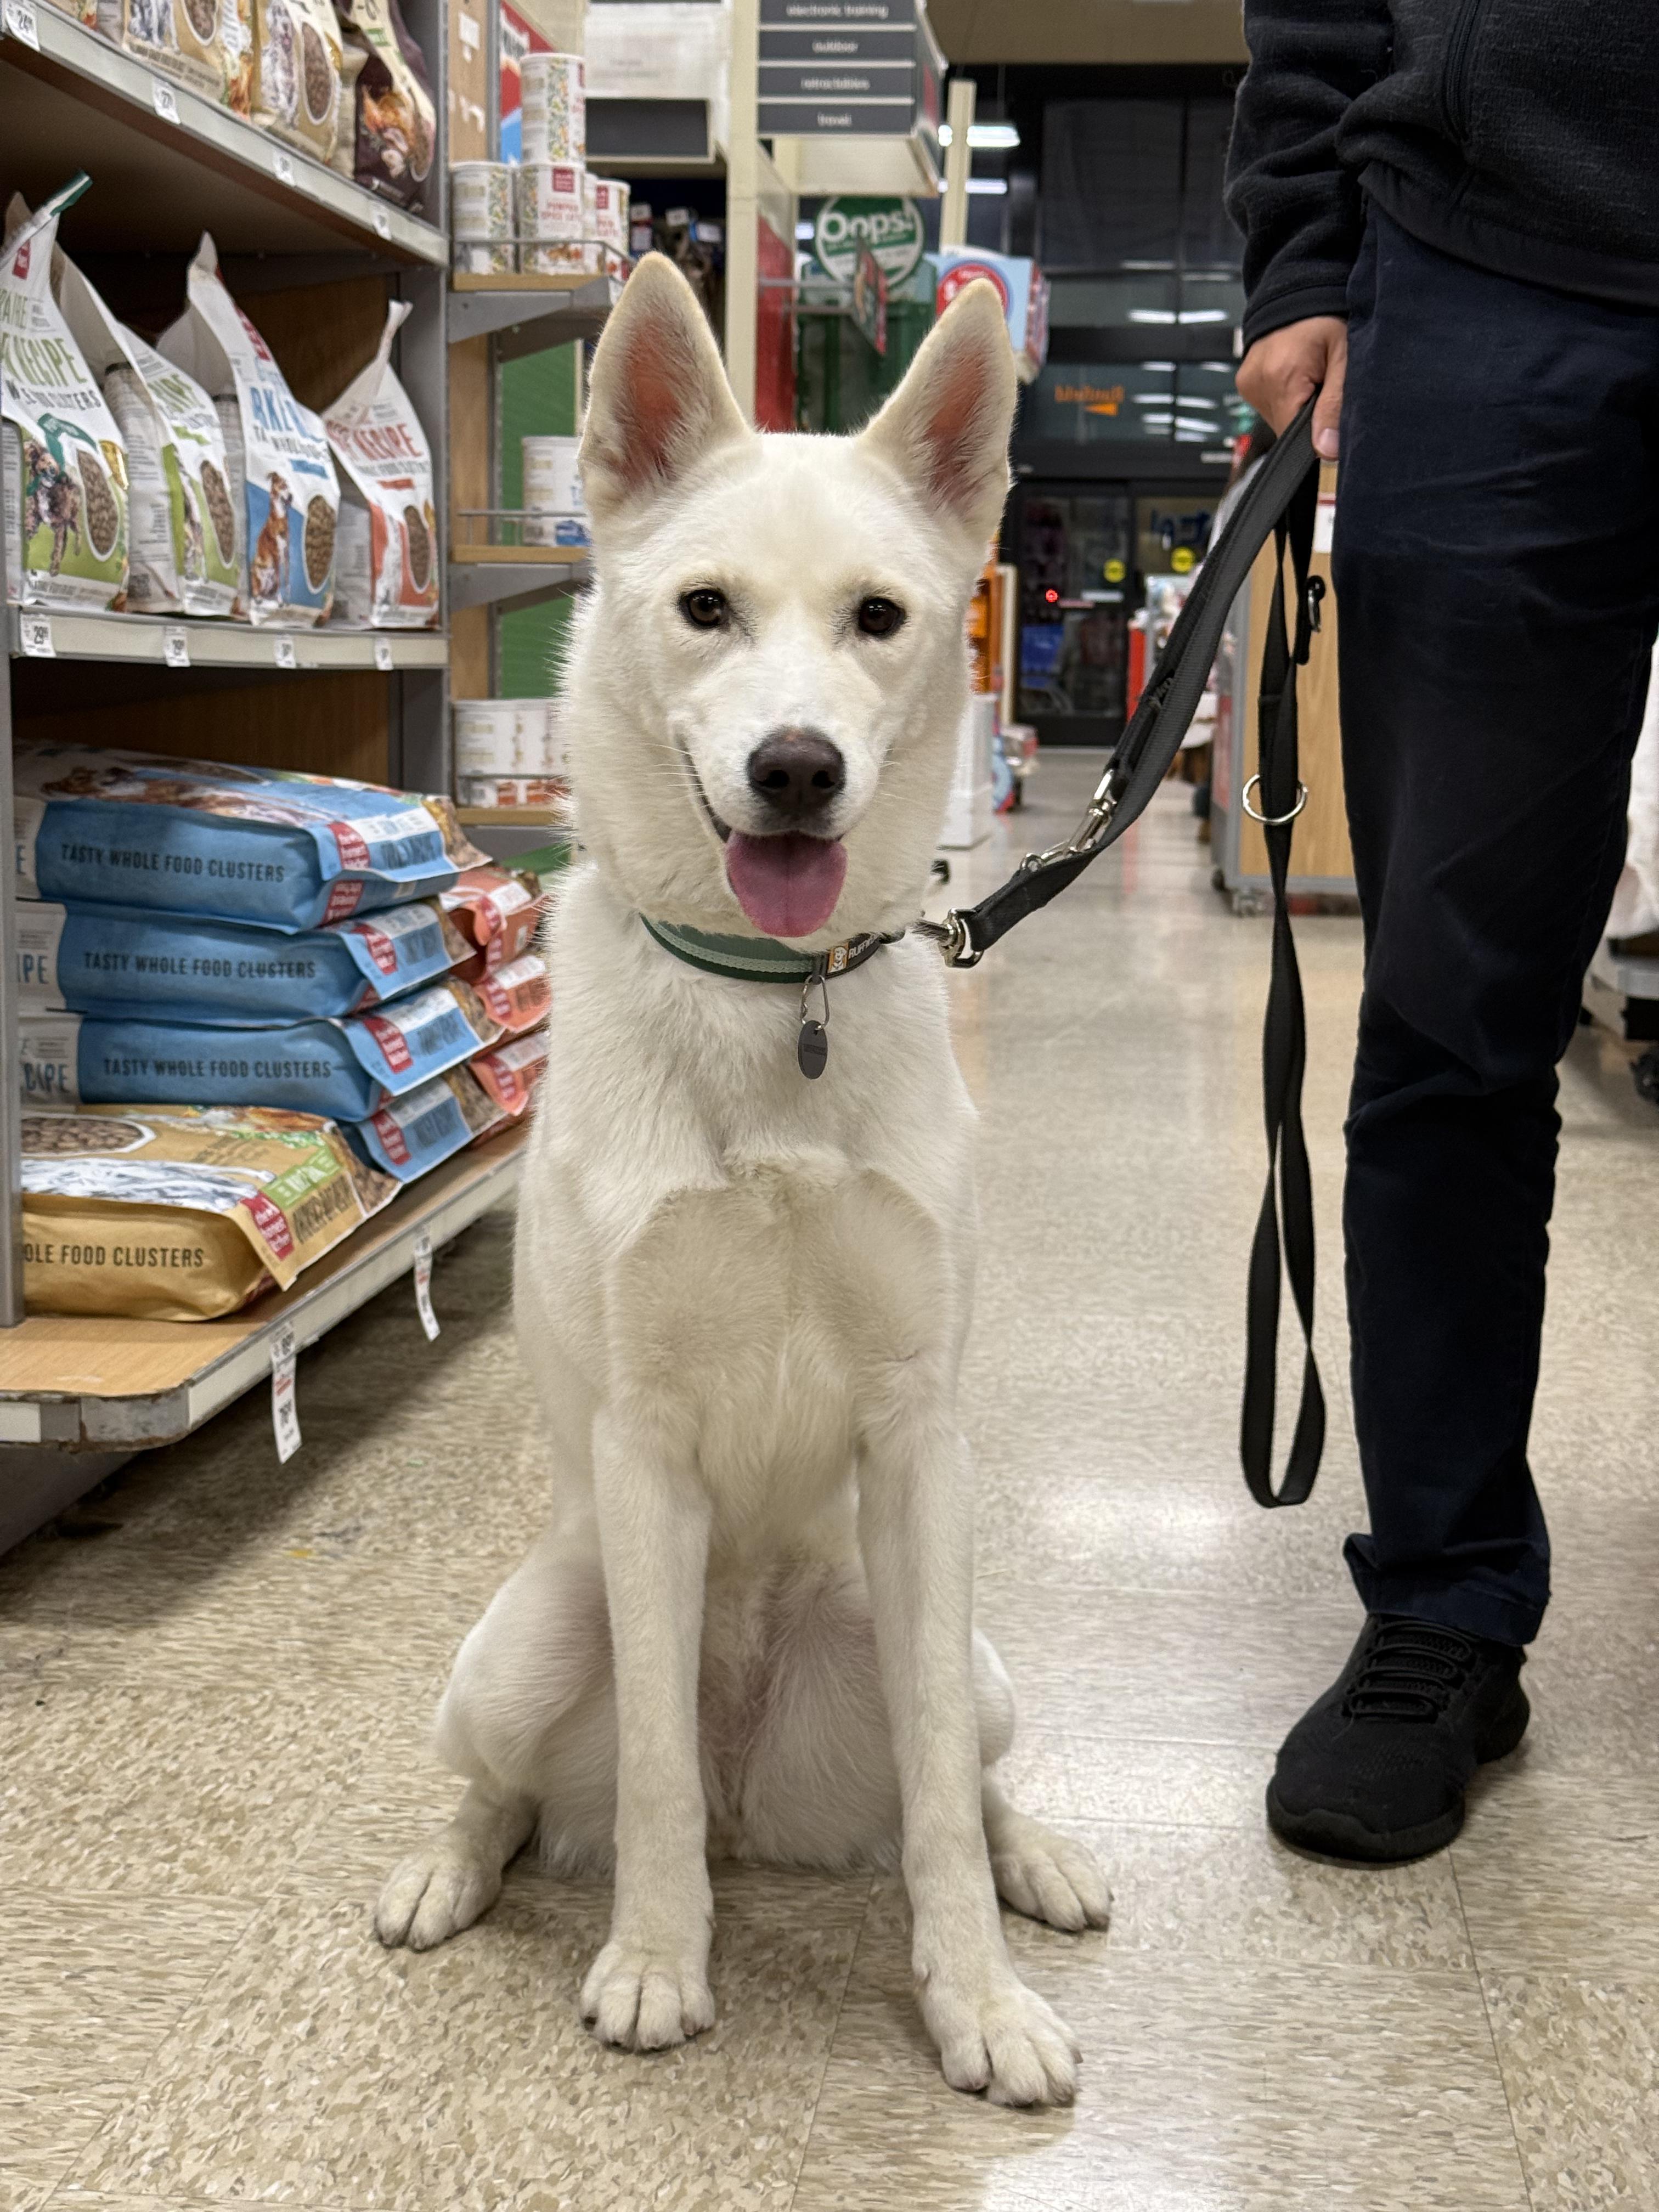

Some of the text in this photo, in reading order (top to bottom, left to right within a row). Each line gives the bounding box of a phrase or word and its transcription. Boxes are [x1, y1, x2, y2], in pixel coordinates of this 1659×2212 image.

[844, 3, 889, 19] training
[817, 112, 852, 126] travel
[61, 843, 286, 883] TASTY WHOLE FOOD CLUSTERS
[84, 952, 316, 979] TASTY WHOLE FOOD CLUSTERS
[104, 1058, 332, 1079] TASTY WHOLE FOOD CLUSTERS
[60, 1245, 106, 1266] FOOD
[113, 1246, 205, 1268] CLUSTERS
